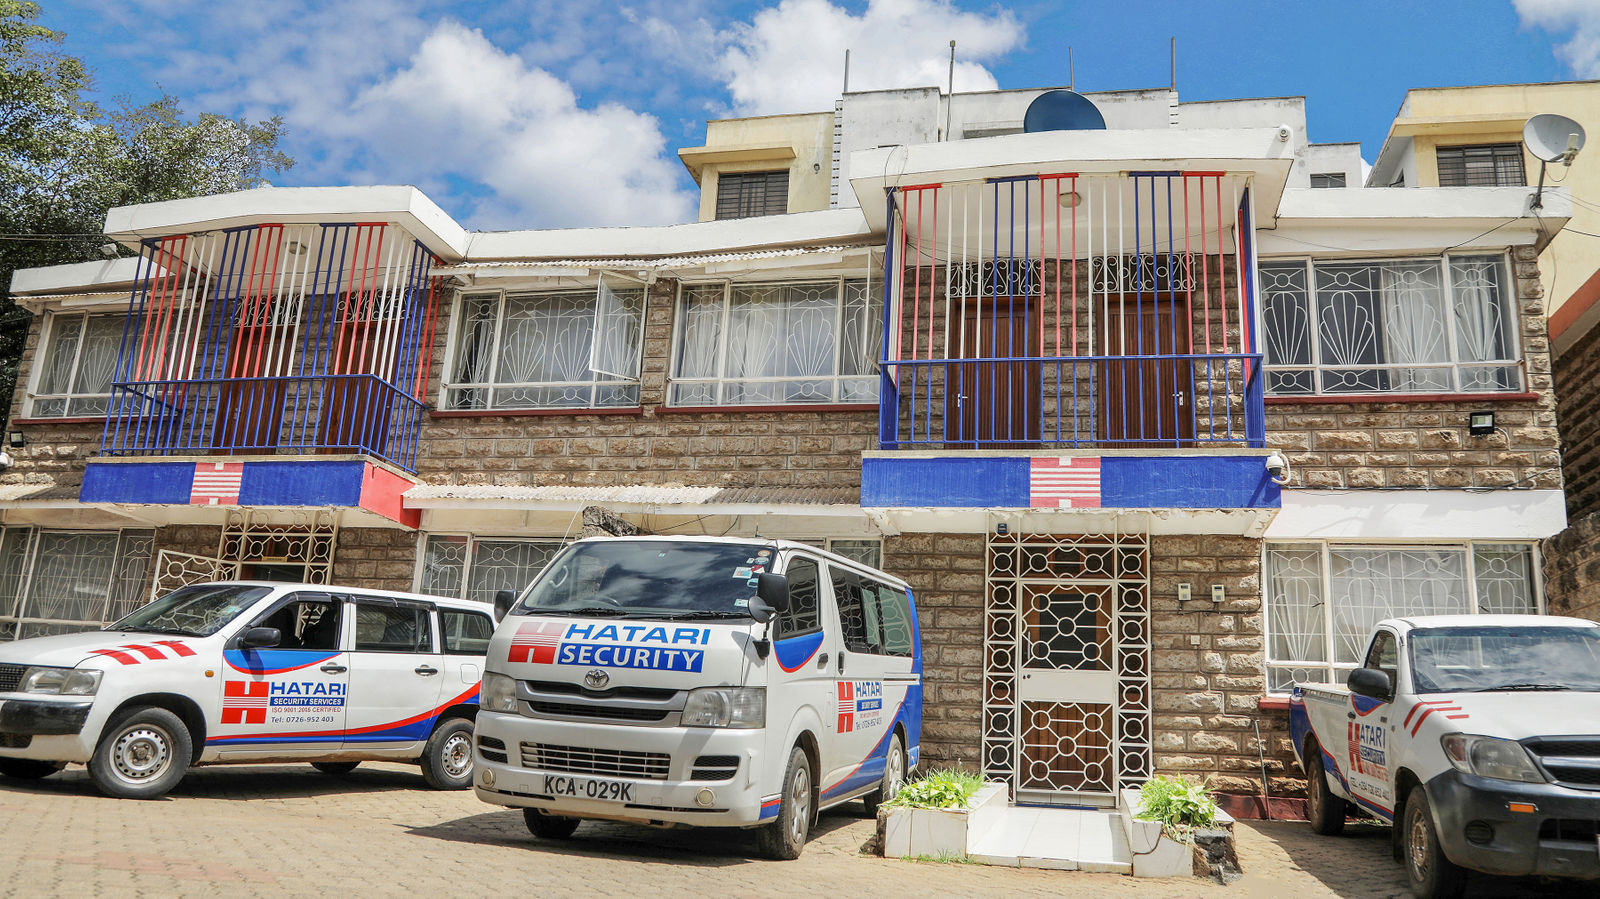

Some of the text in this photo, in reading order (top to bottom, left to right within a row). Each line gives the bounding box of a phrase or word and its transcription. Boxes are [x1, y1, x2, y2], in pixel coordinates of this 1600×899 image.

[565, 623, 711, 645] HATARI
[561, 645, 699, 671] SECURITY
[270, 682, 346, 696] HATARI
[855, 681, 882, 697] HATARI
[273, 697, 342, 706] SECURITY SERVICES
